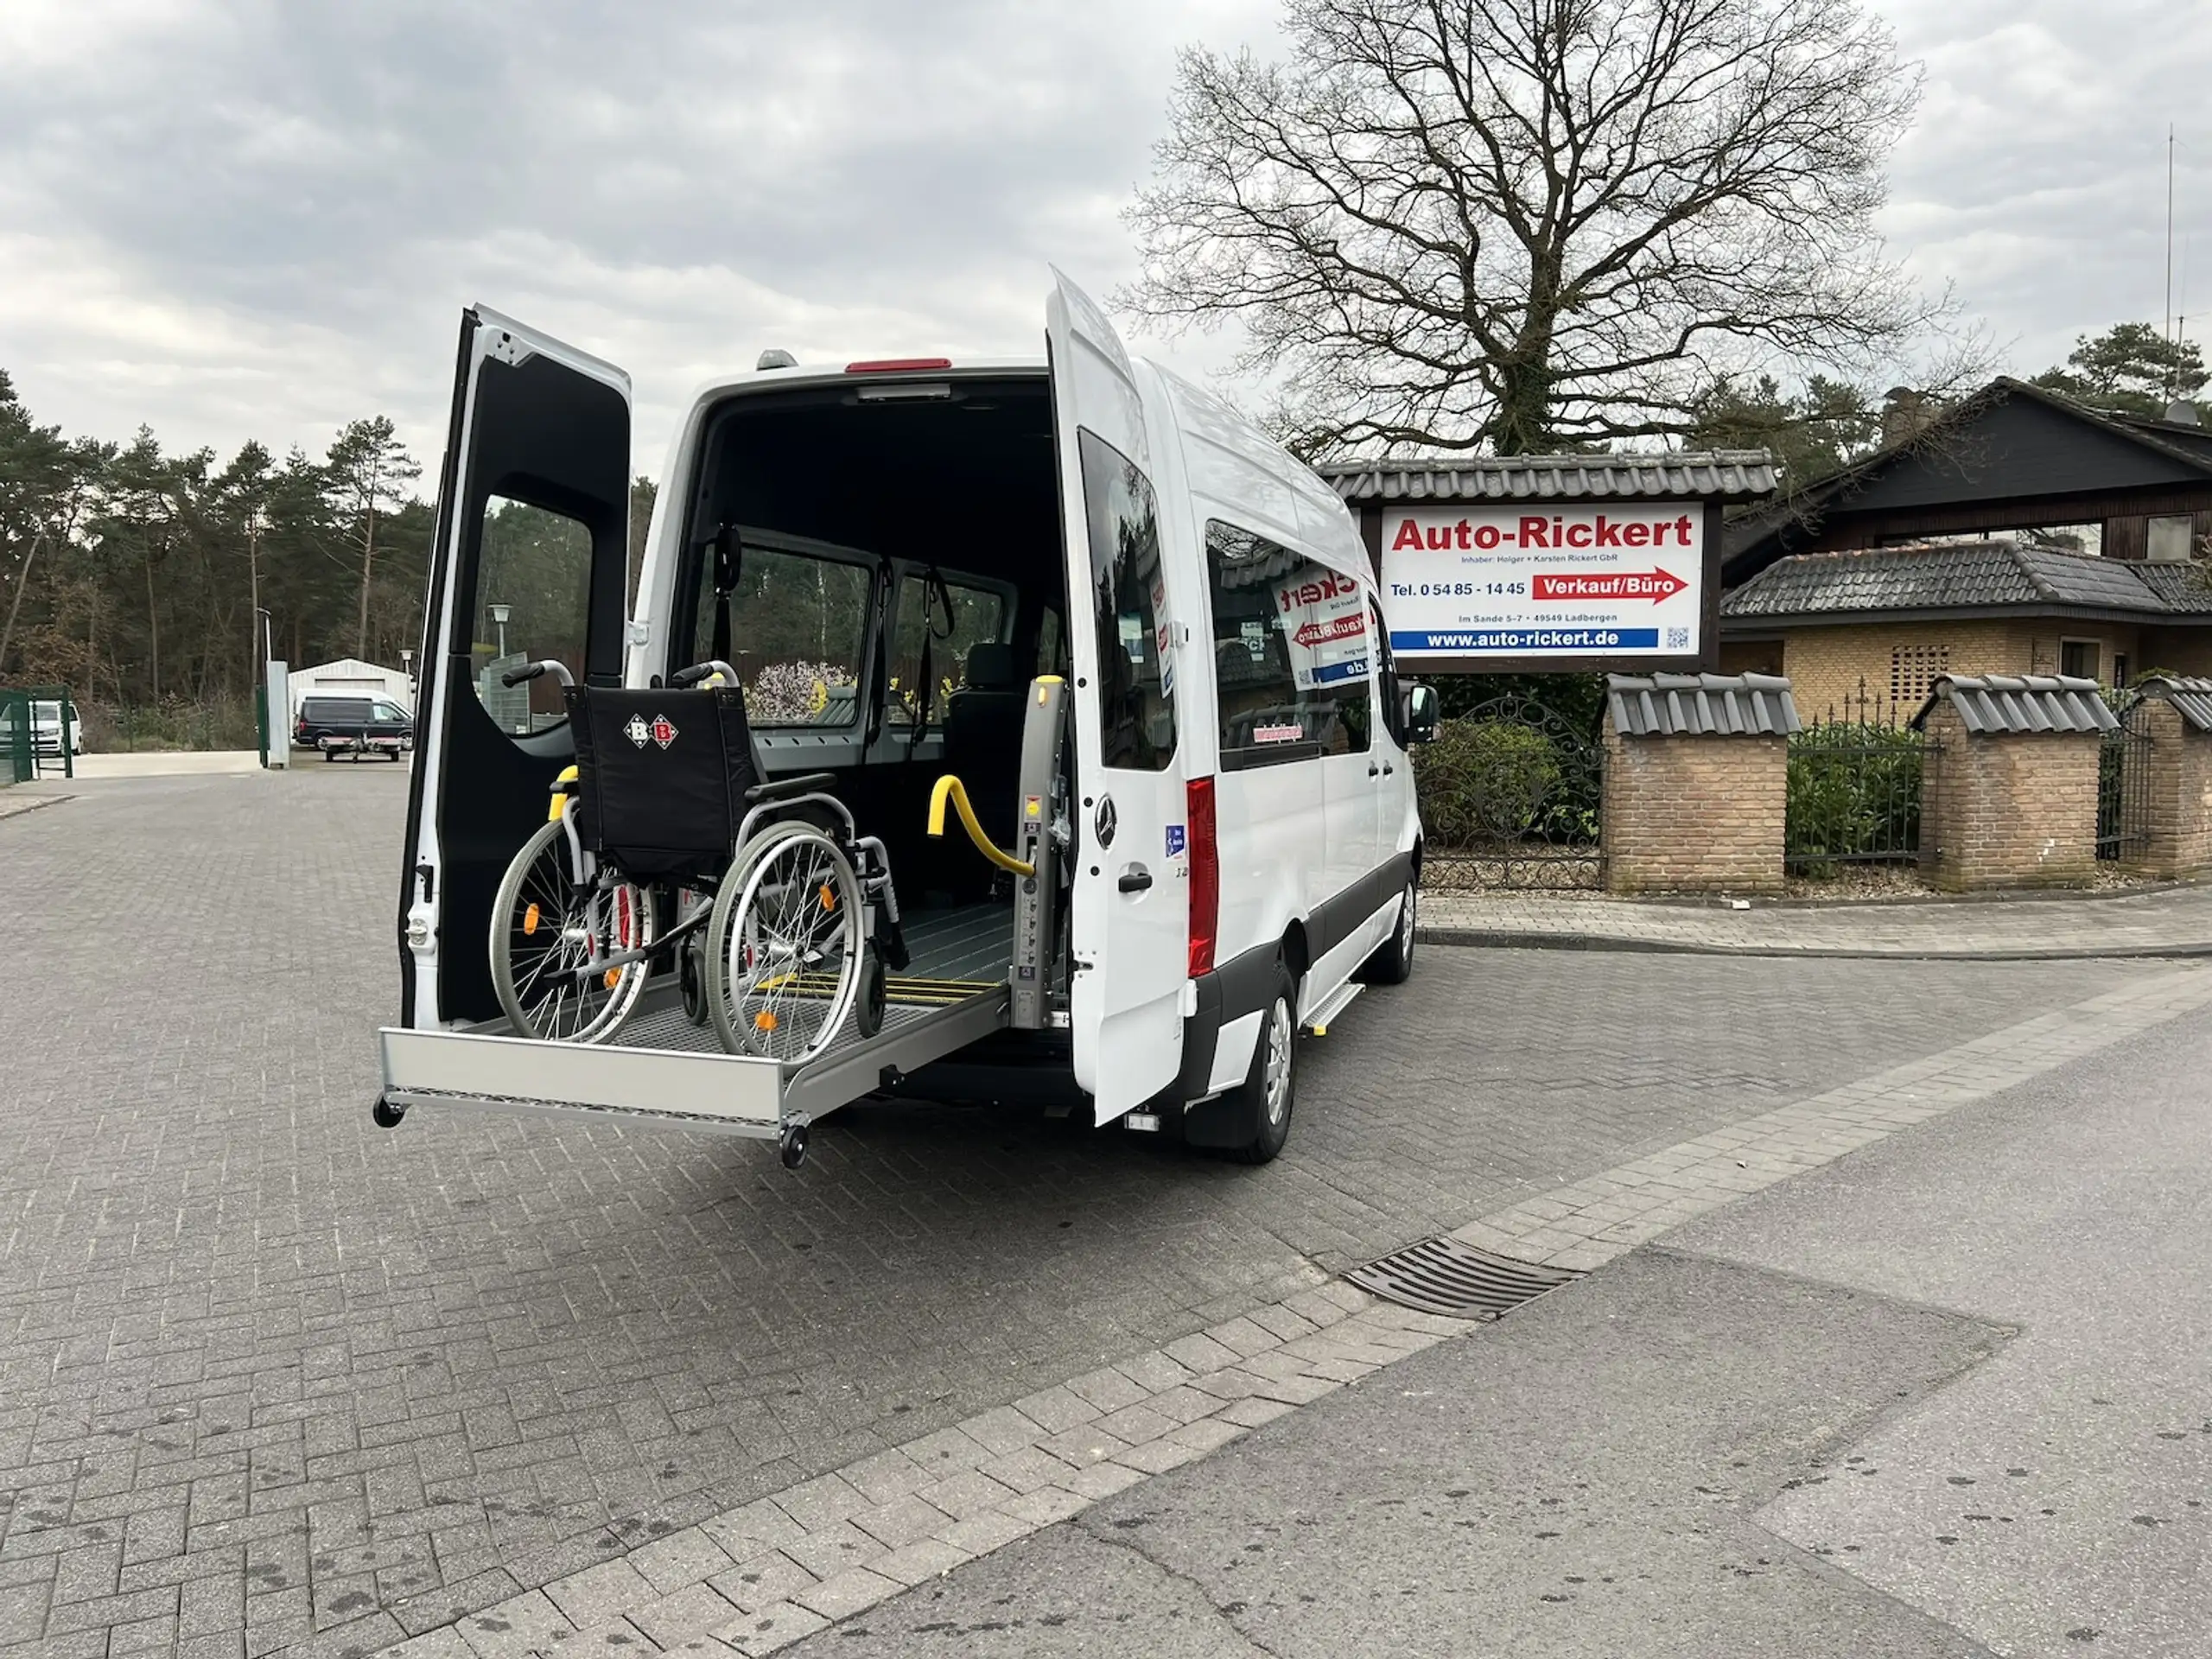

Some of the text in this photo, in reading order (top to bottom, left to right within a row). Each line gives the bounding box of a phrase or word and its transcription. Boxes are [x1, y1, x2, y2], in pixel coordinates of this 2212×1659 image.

[1391, 514, 1693, 550] Auto-Rickert
[1497, 555, 1524, 564] Holger
[1599, 553, 1618, 562] GbR
[1390, 584, 1417, 596] Tel.
[1543, 577, 1675, 595] Verkauf/Büro
[1474, 614, 1503, 623] Sande
[1534, 613, 1562, 622] 49549
[1565, 613, 1618, 623] Ladbergen
[1427, 630, 1619, 646] www.auto-rickert.de
